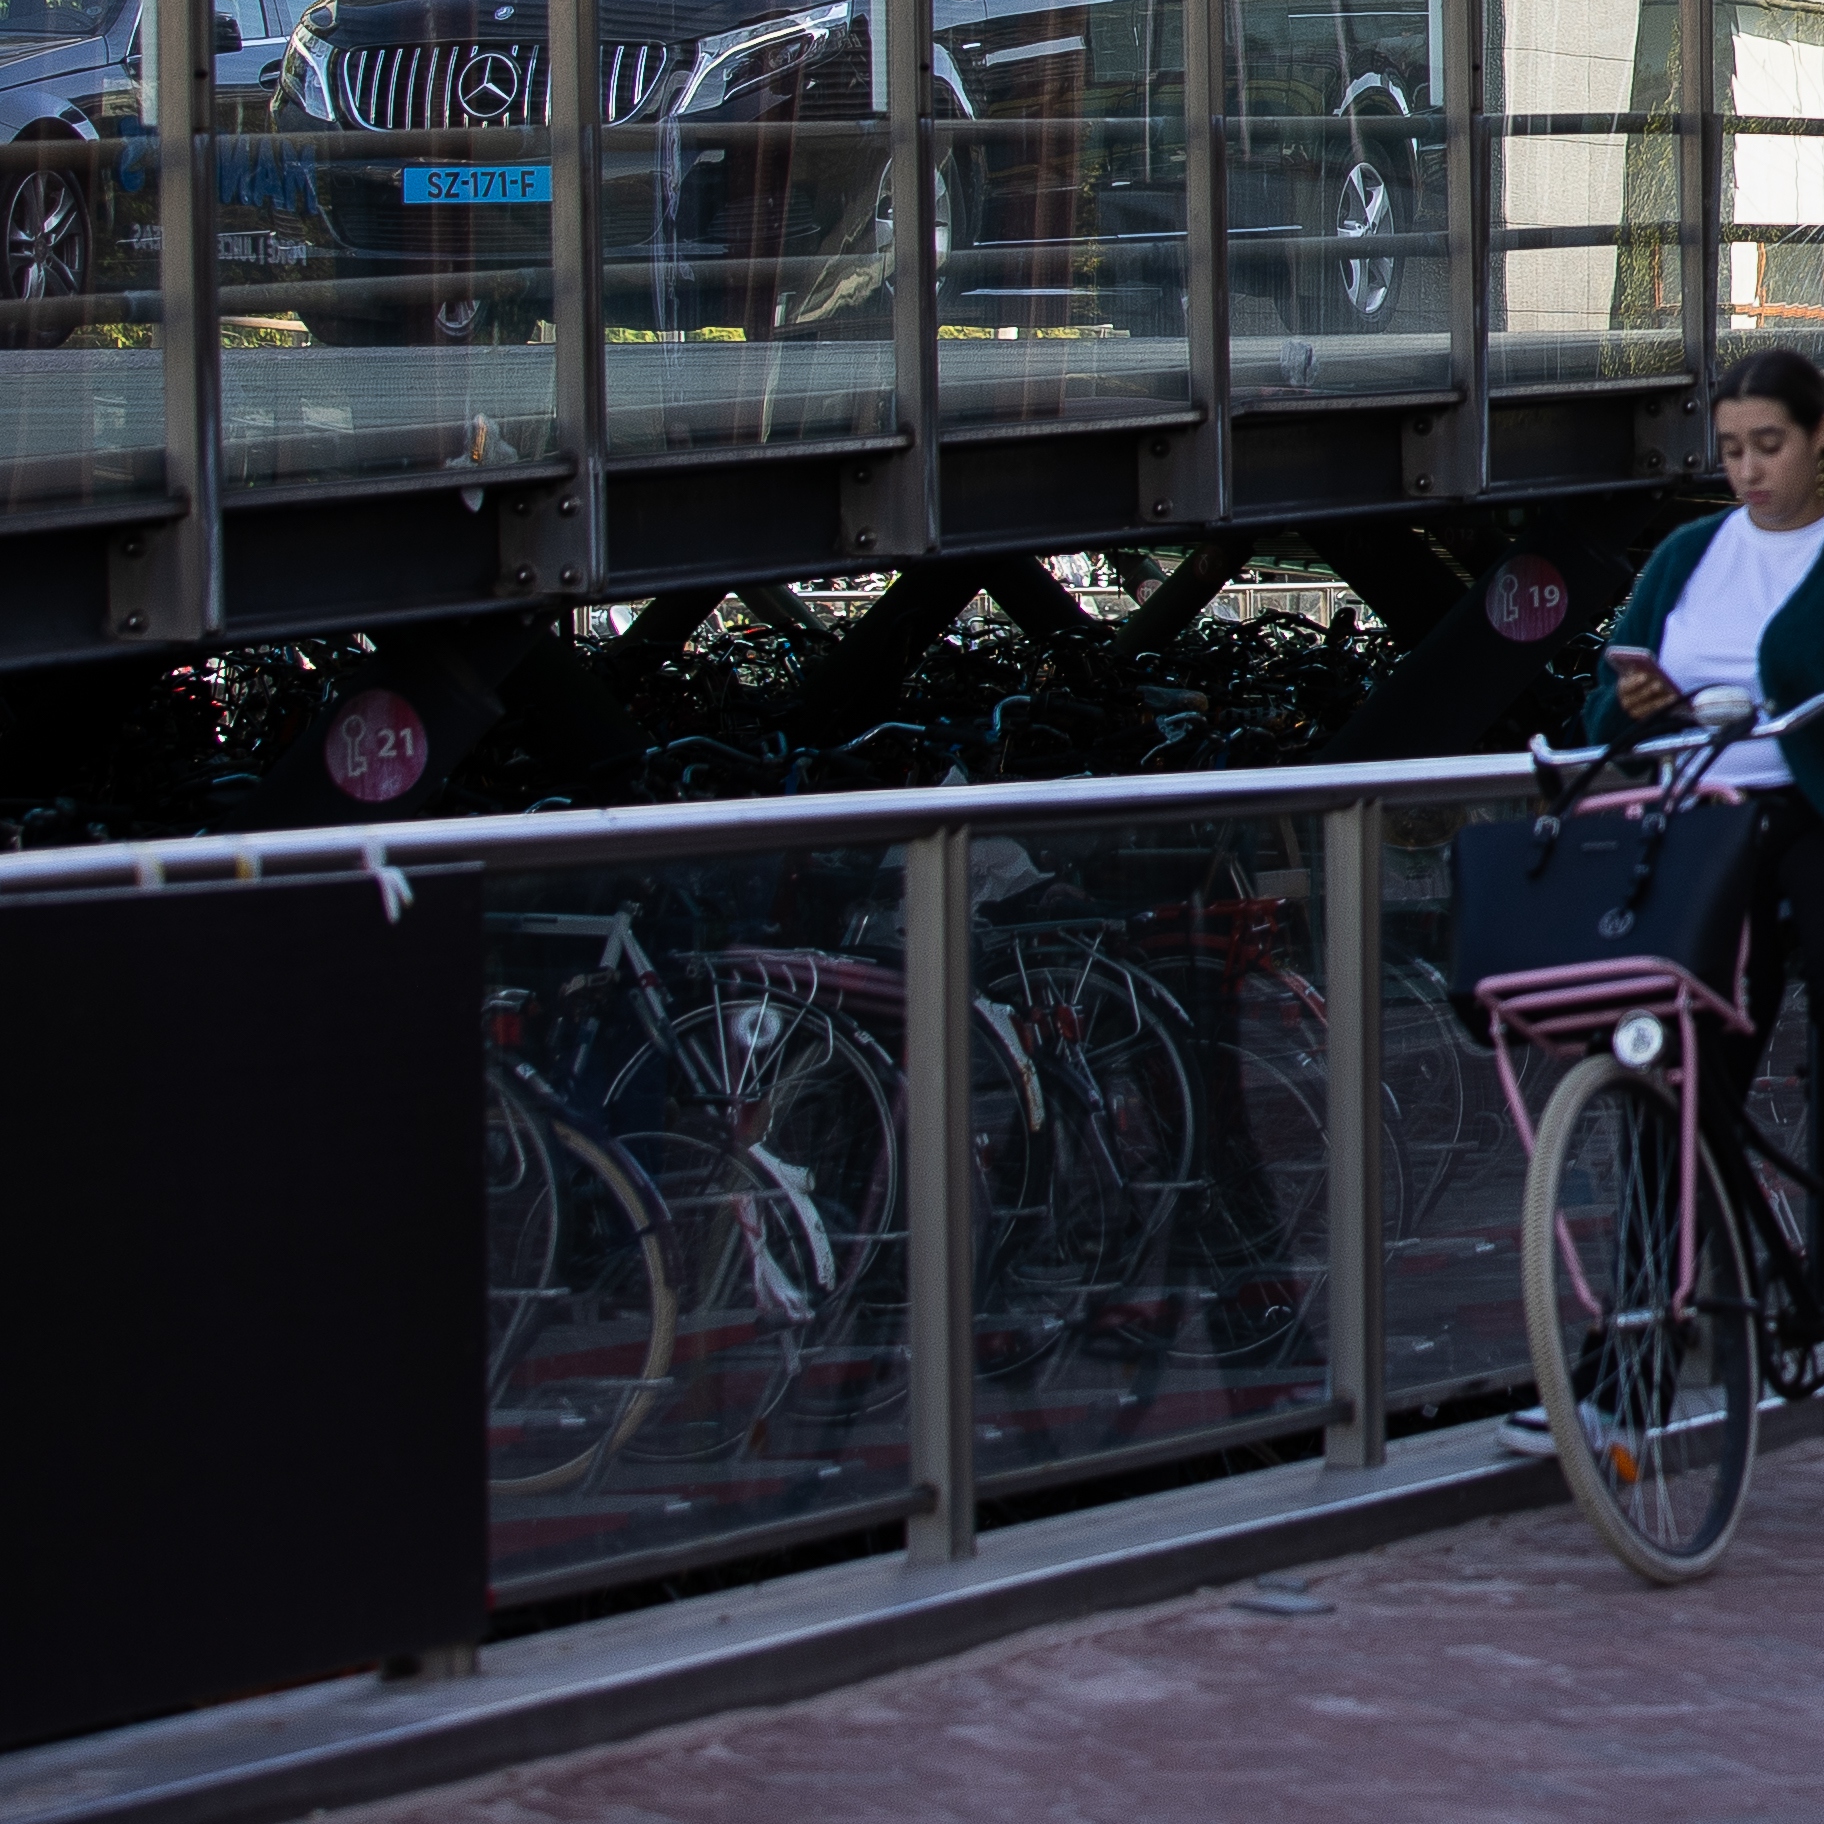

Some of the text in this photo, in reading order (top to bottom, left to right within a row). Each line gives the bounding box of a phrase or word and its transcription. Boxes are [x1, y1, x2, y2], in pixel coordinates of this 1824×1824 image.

[427, 170, 536, 199] SZ-171-F
[1529, 584, 1561, 608] 19
[377, 727, 414, 759] 21
